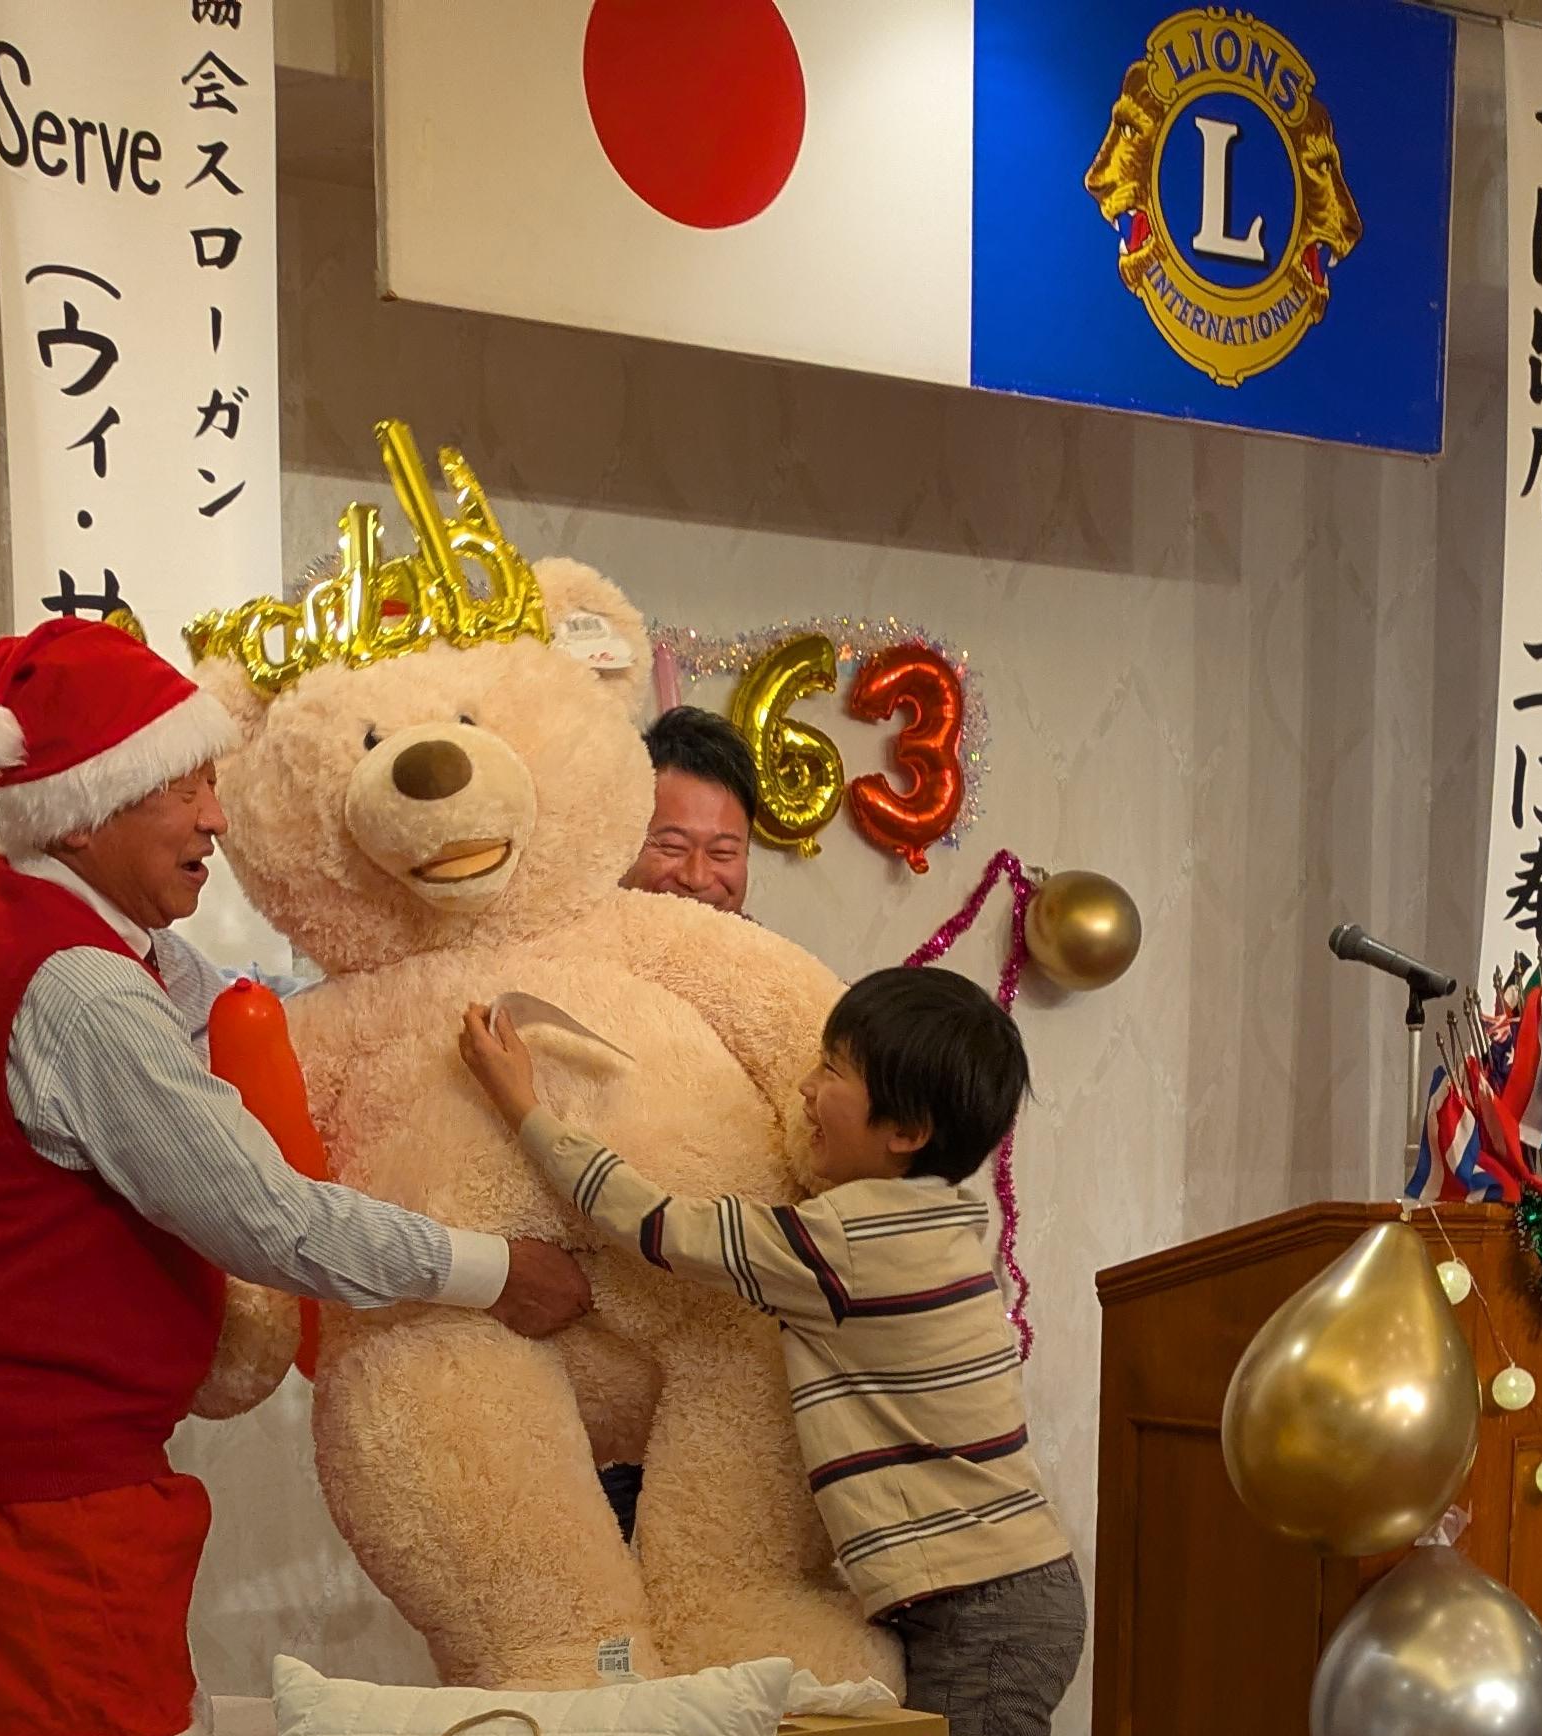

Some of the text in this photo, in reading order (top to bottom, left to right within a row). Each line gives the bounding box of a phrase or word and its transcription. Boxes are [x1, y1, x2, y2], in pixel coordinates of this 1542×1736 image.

[1162, 26, 1303, 114] LIONS
[1192, 116, 1265, 262] L
[1144, 264, 1309, 346] INTERNATIONAL
